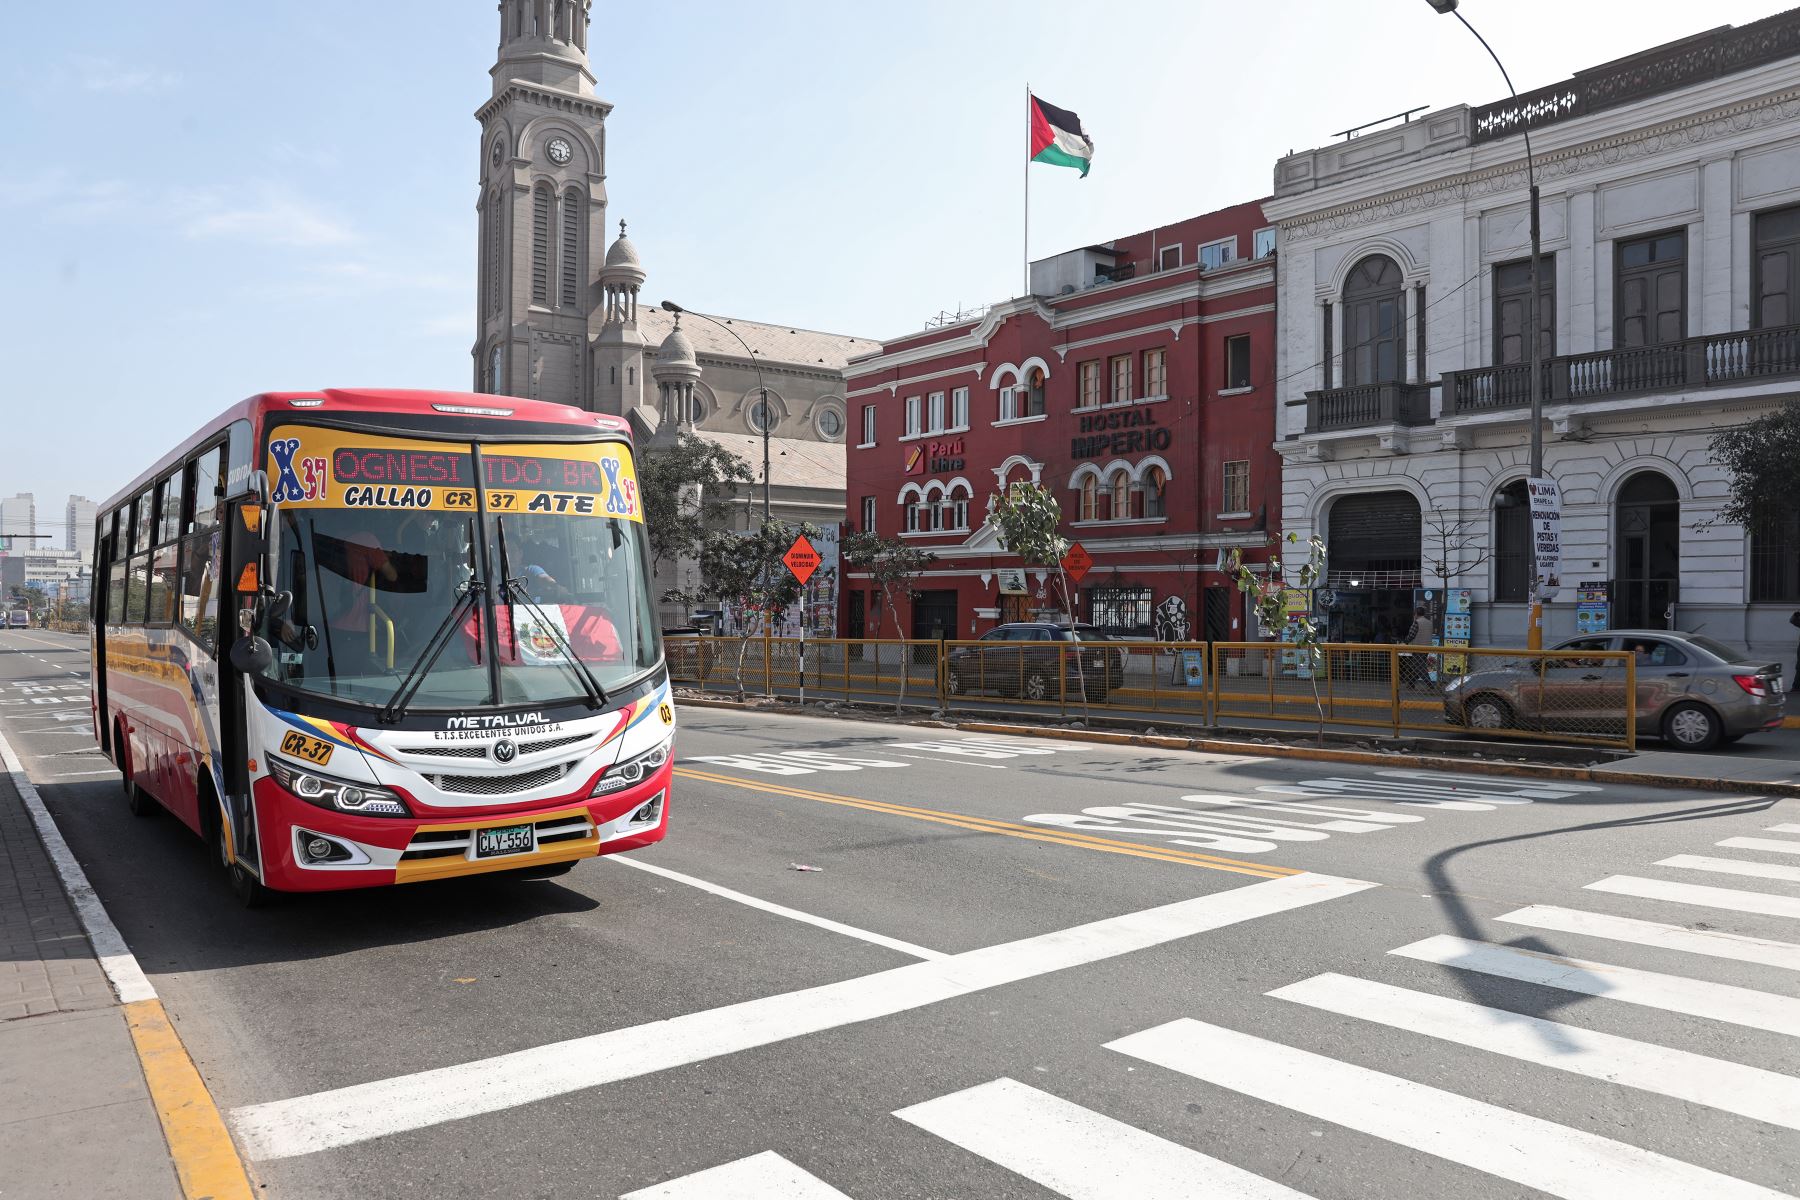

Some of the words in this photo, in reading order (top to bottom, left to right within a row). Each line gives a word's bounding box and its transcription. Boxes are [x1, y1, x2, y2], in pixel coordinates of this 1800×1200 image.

[1080, 408, 1156, 433] HOSTAL
[930, 437, 963, 457] Perú
[1071, 427, 1171, 460] IMPERIO
[335, 452, 462, 482] OGNESI
[930, 457, 965, 474] Libre
[344, 485, 433, 508] CALLAO
[445, 491, 473, 507] CR
[490, 493, 516, 508] 37
[528, 493, 595, 513] ATE
[1537, 486, 1557, 497] LIMA
[1531, 510, 1560, 521] RENOVACIÓN
[1543, 521, 1551, 531] DE
[1537, 531, 1554, 542] PISTAS
[1554, 532, 1559, 541] Y
[1536, 542, 1560, 553] VEREDAS
[447, 711, 551, 730] METALVAL
[660, 704, 672, 724] 03
[514, 725, 546, 736] UNIDOS
[548, 723, 564, 733] S.A.
[284, 733, 332, 761] CR-37
[883, 738, 1093, 758] BUS
[684, 751, 912, 775] BUS
[1255, 770, 1604, 811] SOLO
[1022, 794, 1426, 853] SOLO
[480, 830, 530, 852] CLY-556
